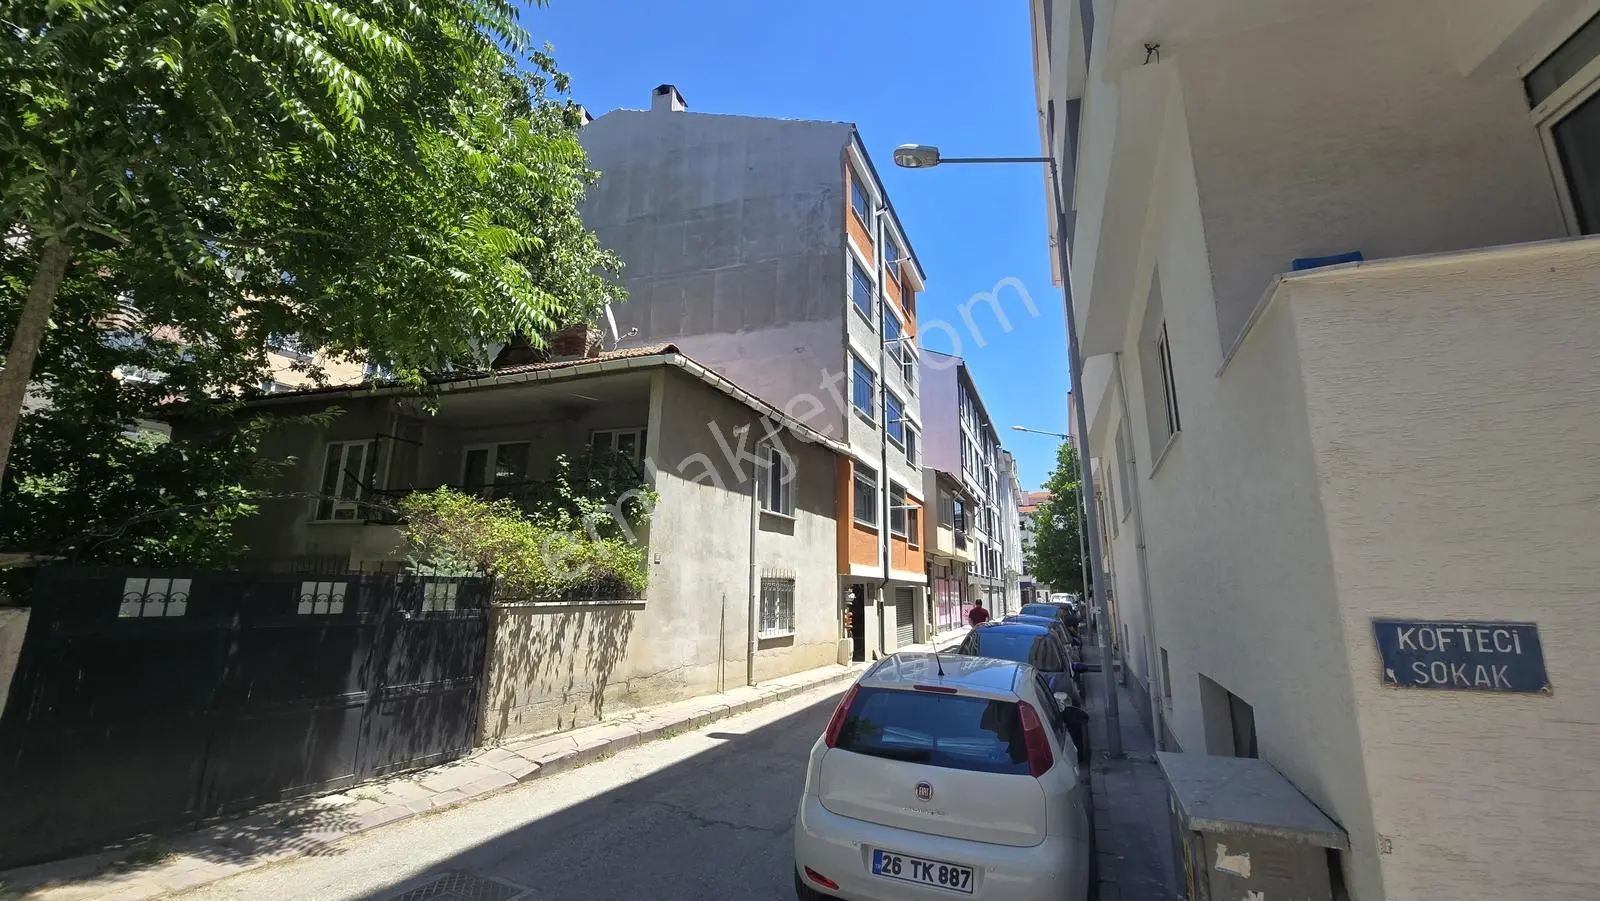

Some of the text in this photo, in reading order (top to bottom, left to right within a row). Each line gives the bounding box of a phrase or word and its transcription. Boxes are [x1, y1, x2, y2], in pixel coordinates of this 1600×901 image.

[1411, 661, 1513, 688] SOKAK
[918, 786, 930, 796] FIAT
[881, 854, 971, 889] 26 TK 887
